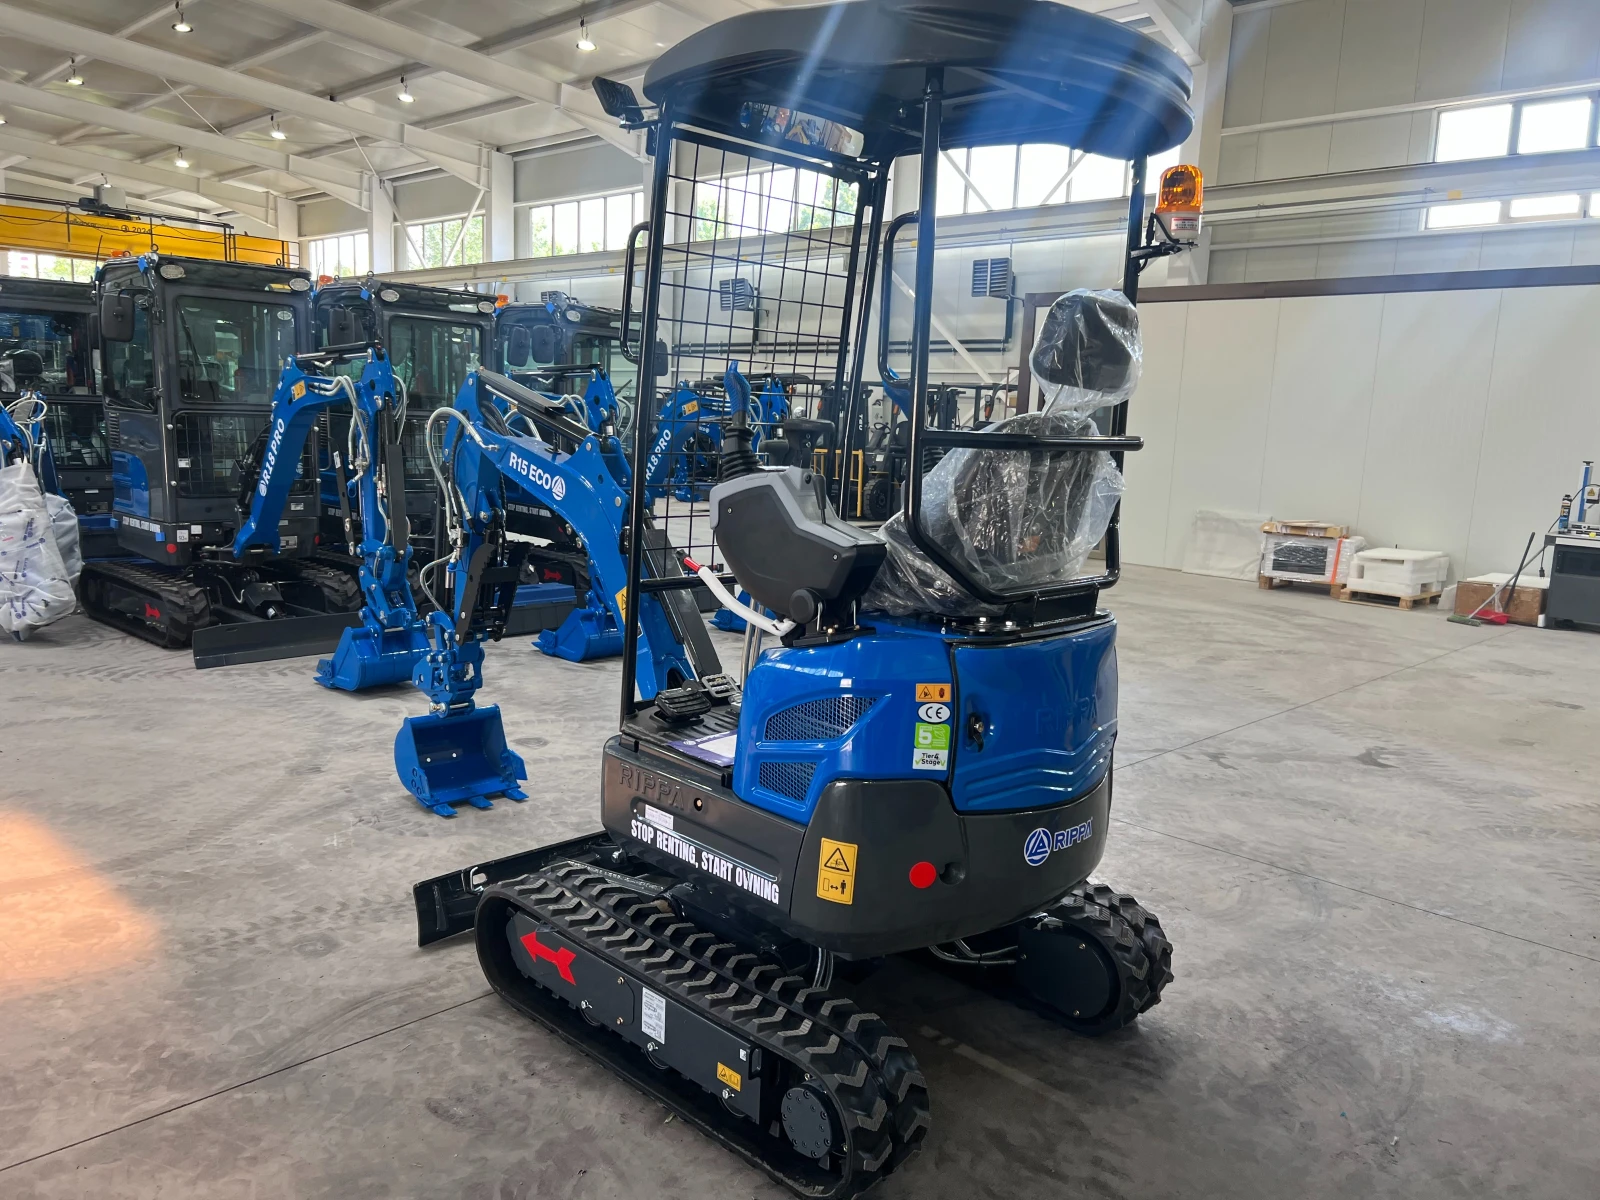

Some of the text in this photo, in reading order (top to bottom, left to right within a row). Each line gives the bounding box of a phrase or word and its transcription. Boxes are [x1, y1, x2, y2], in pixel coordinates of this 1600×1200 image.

[262, 418, 285, 485] R18PRO
[509, 451, 551, 490] R15 ECO
[926, 706, 943, 719] CE
[619, 763, 685, 811] RIPPA
[1053, 819, 1093, 852] RIPPA
[631, 819, 780, 905] STOP RENTING, START OWNING
